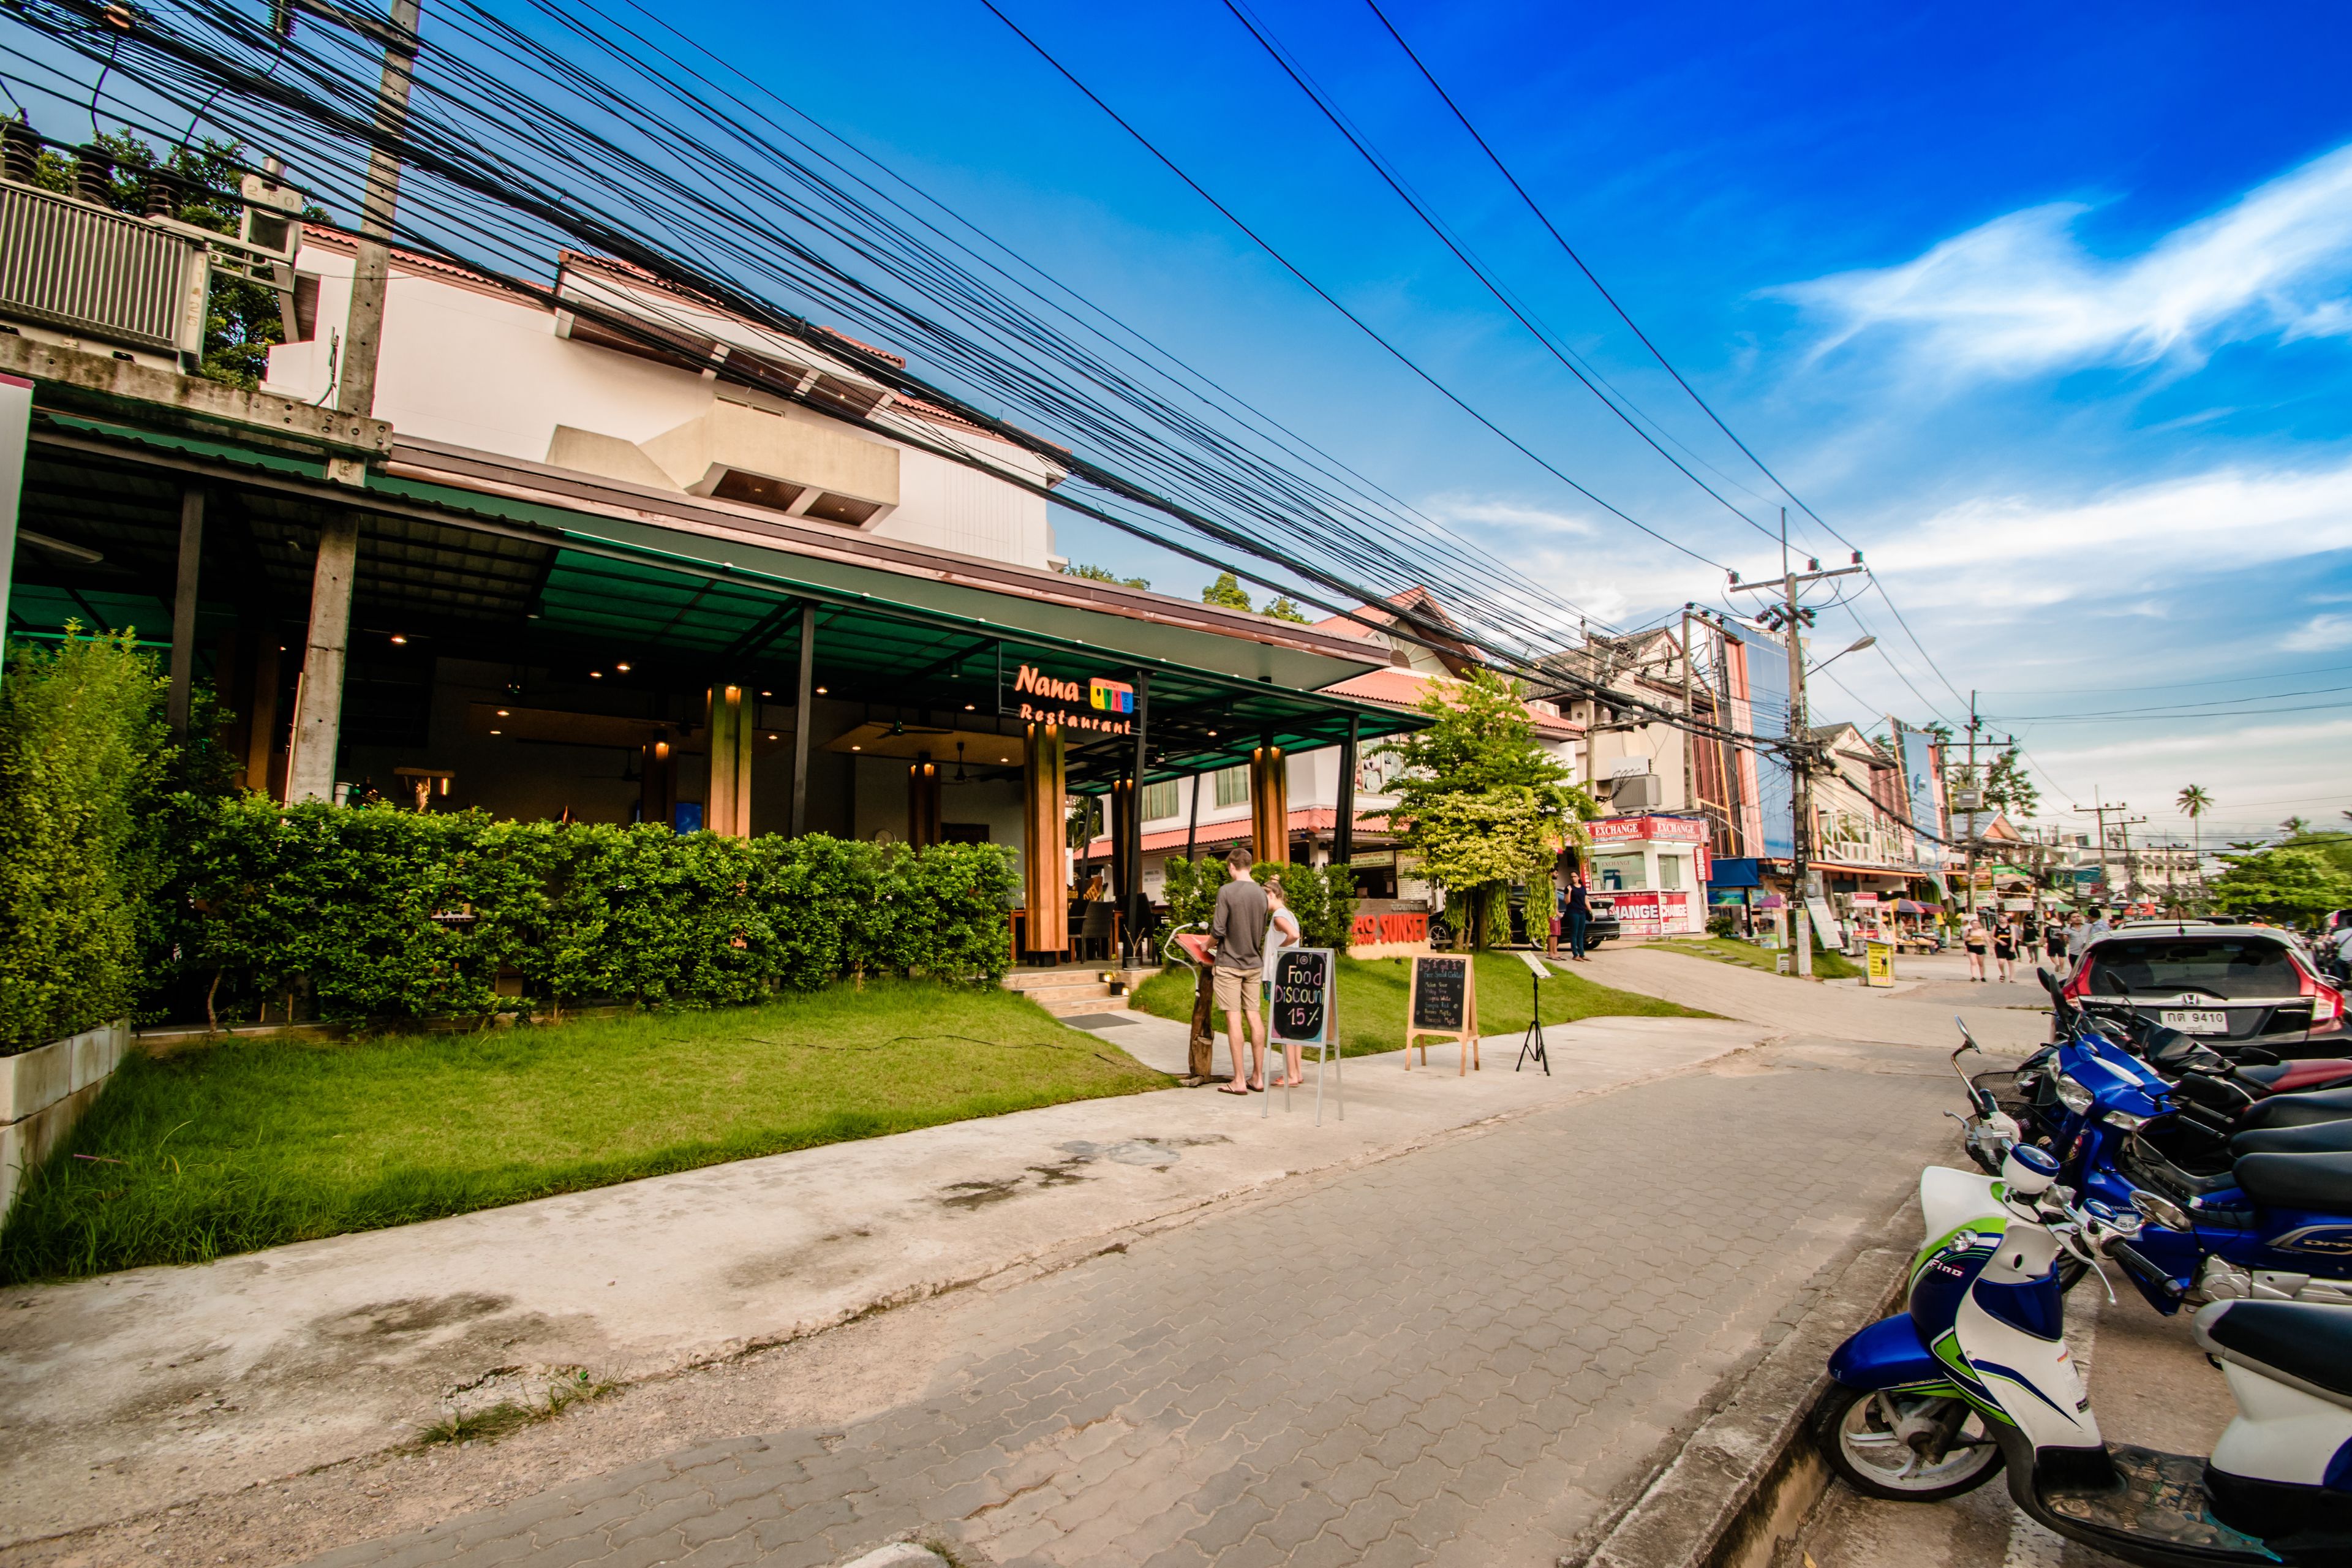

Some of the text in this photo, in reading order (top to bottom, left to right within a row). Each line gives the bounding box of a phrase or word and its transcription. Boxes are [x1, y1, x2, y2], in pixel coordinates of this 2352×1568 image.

[247, 184, 294, 207] 250
[1015, 665, 1079, 702] Nana
[1020, 703, 1131, 735] Restaurant
[1595, 823, 1638, 836] EXCHANGE
[1657, 823, 1695, 834] EXCHANGE
[1615, 905, 1659, 919] HANGE
[1351, 913, 1428, 944] AO SUNSET
[1288, 963, 1323, 987] Food
[2192, 1012, 2223, 1023] 9410
